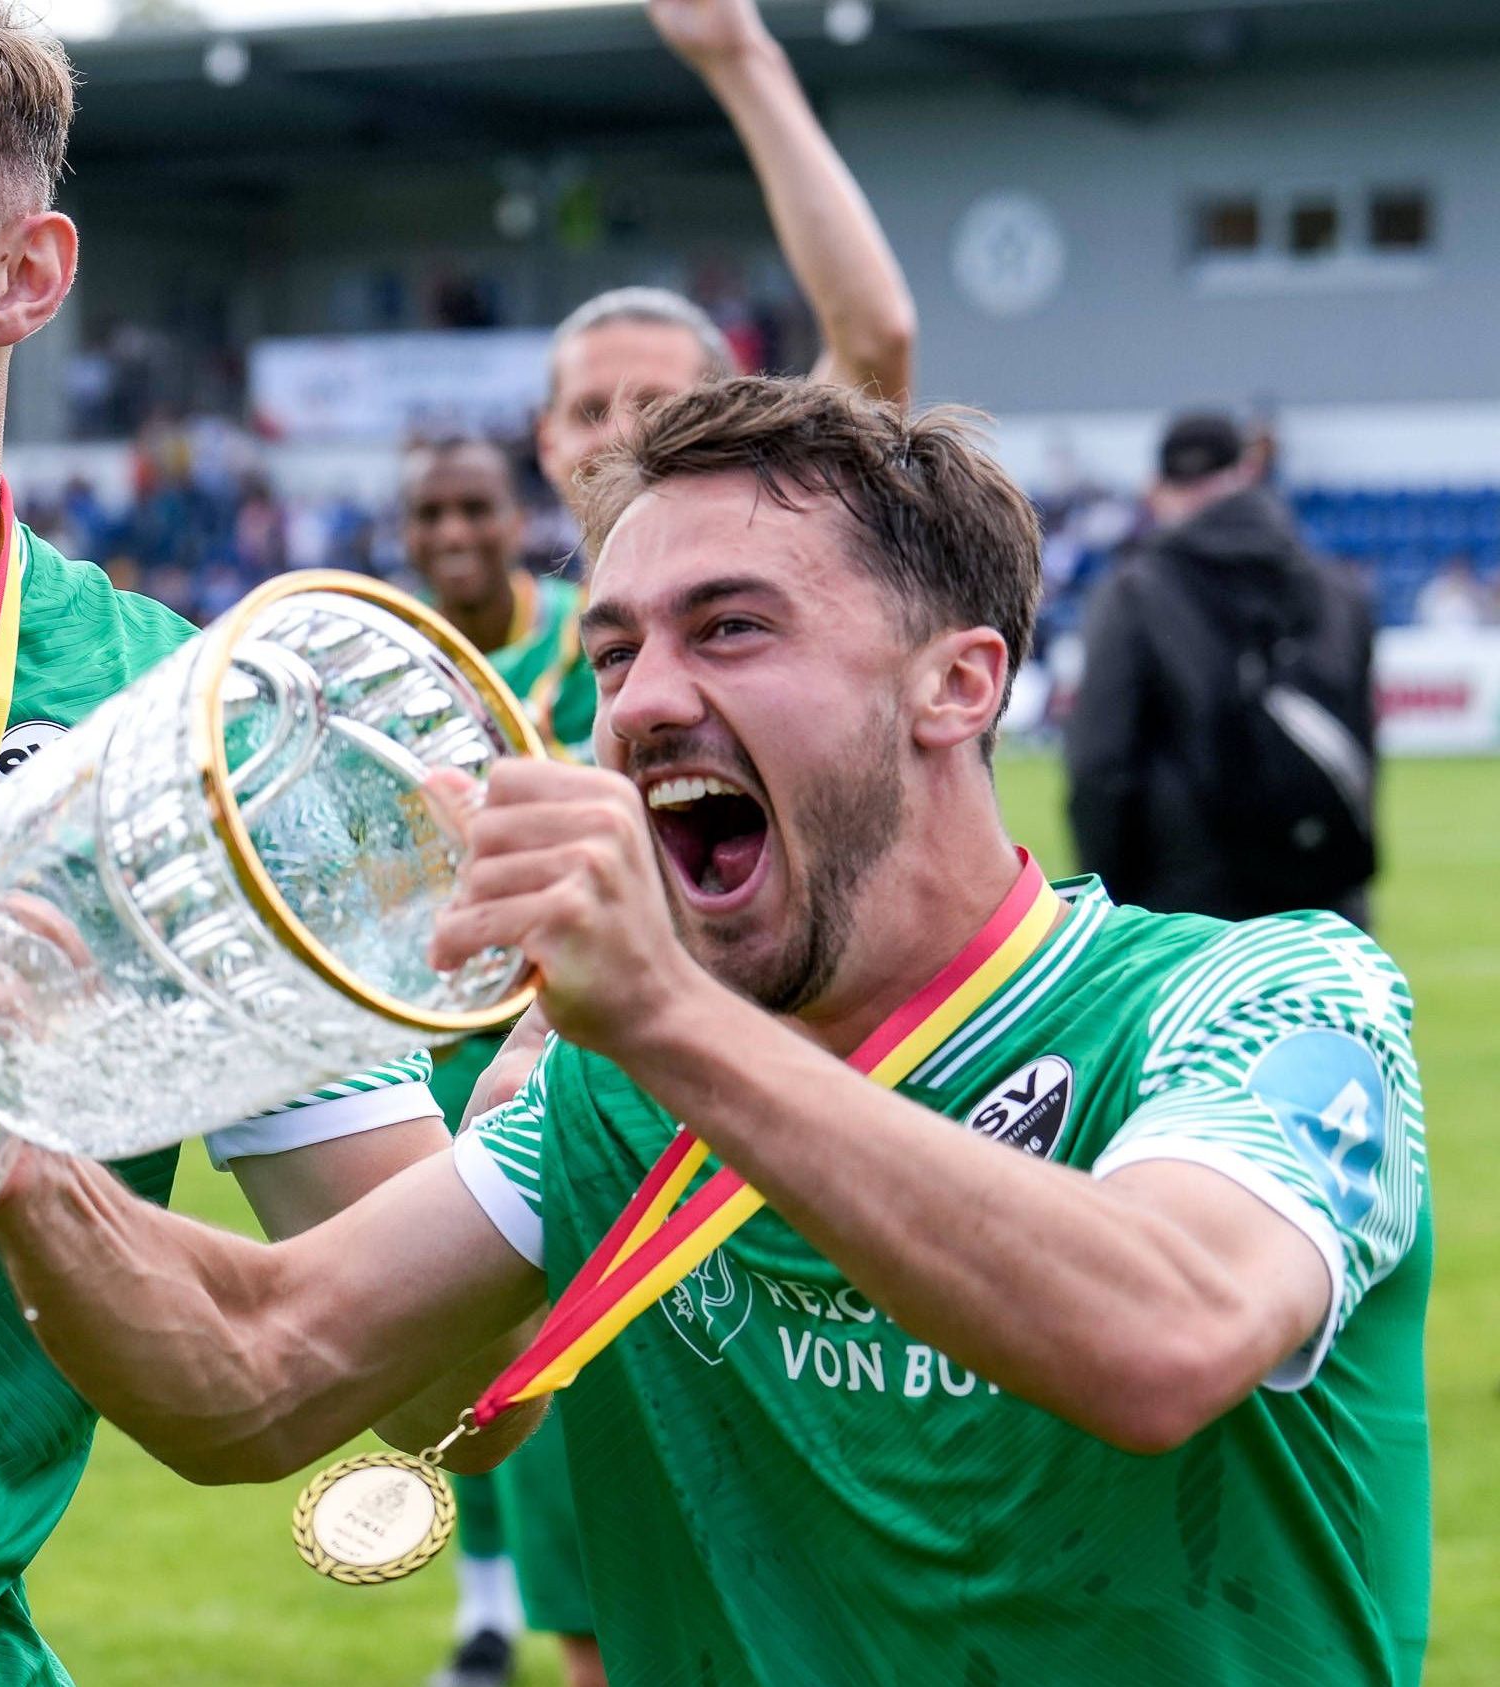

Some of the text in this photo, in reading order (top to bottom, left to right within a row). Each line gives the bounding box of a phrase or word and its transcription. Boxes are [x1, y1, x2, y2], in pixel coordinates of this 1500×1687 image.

[972, 1067, 1038, 1137] SV
[750, 1271, 894, 1324] REIC
[778, 1325, 886, 1392] VON
